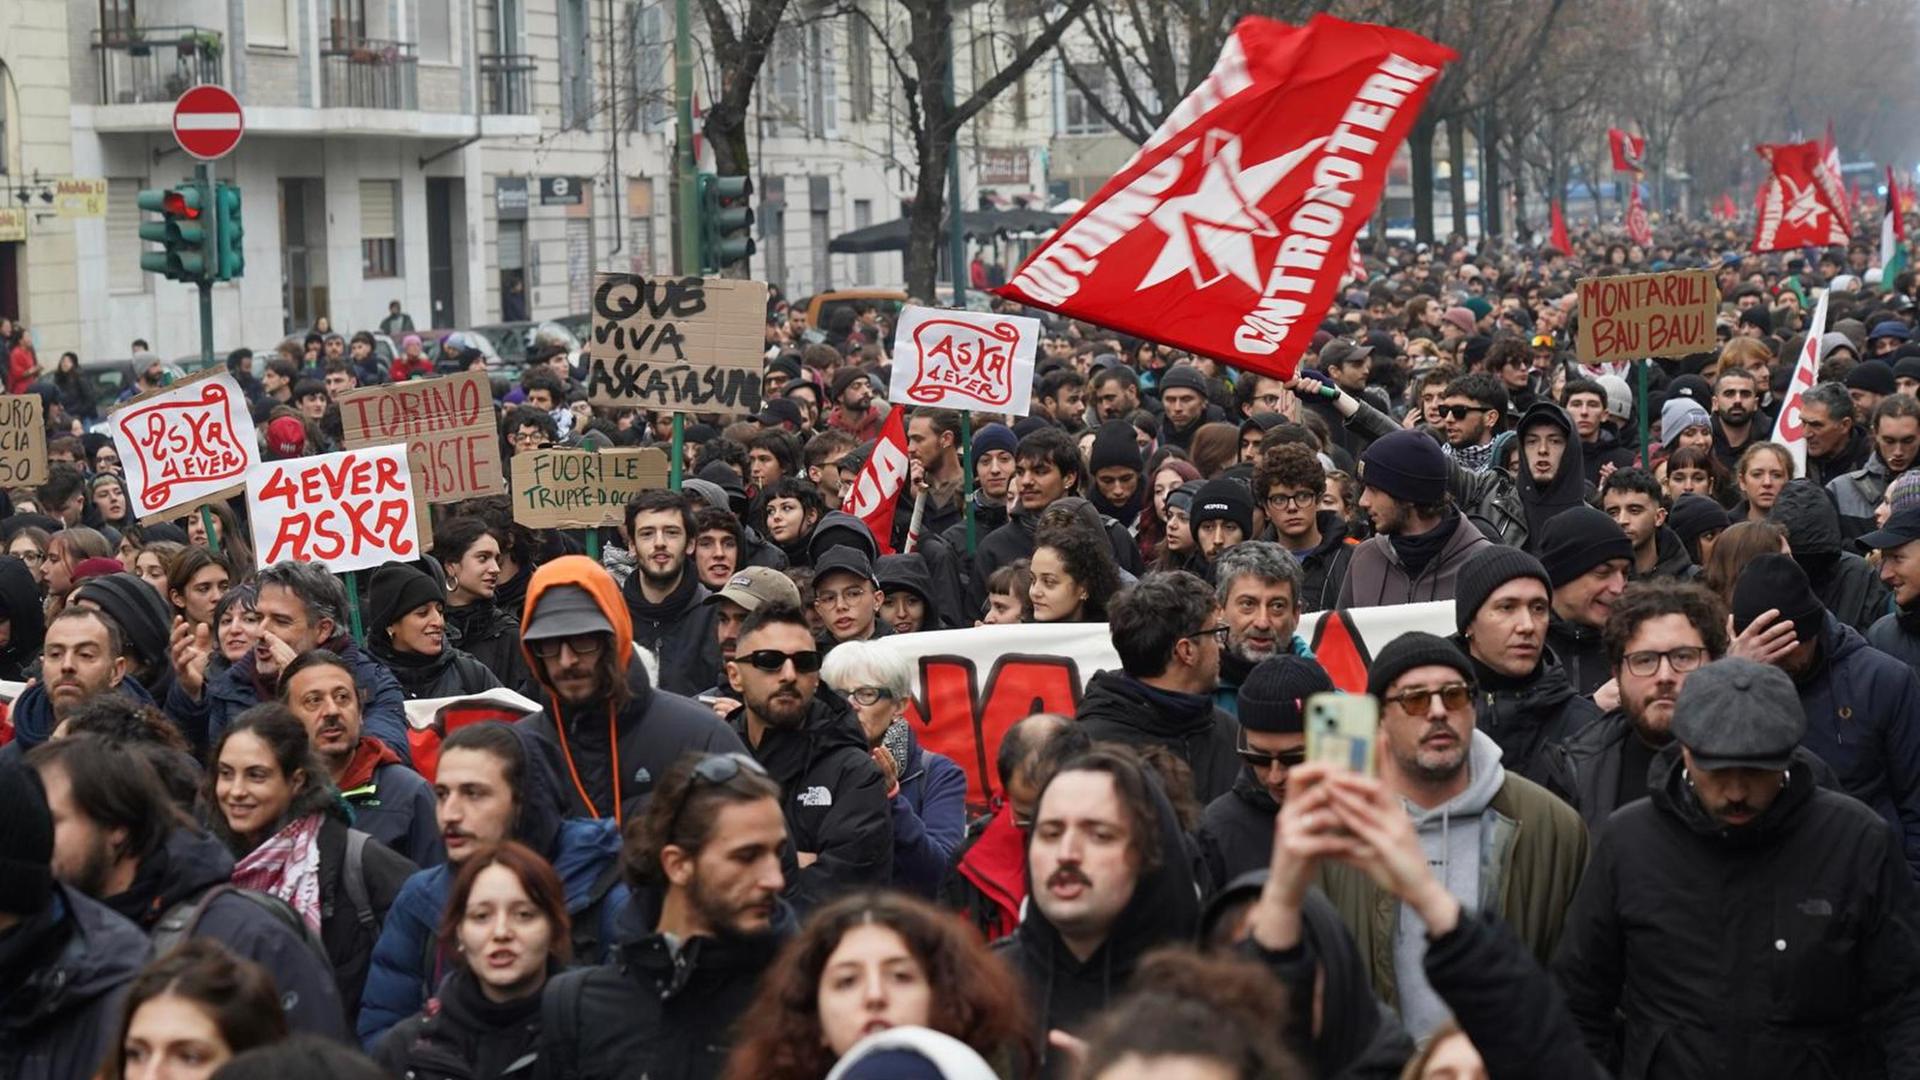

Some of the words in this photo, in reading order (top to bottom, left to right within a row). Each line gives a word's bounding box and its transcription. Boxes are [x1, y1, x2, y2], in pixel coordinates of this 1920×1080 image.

[594, 273, 706, 321] QUE
[1583, 275, 1707, 318] MONTARULI
[595, 321, 685, 359] VIVA
[1592, 318, 1639, 357] BAU
[1648, 311, 1704, 351] BAU!
[927, 335, 1006, 385] ASKA
[345, 379, 480, 441] TORINO
[141, 411, 230, 461] ASKA
[258, 455, 405, 510] 4EVER
[534, 454, 603, 485] FUORI
[615, 457, 640, 480] LE
[523, 486, 592, 511] TRUPPE
[265, 499, 413, 565] ASKA
